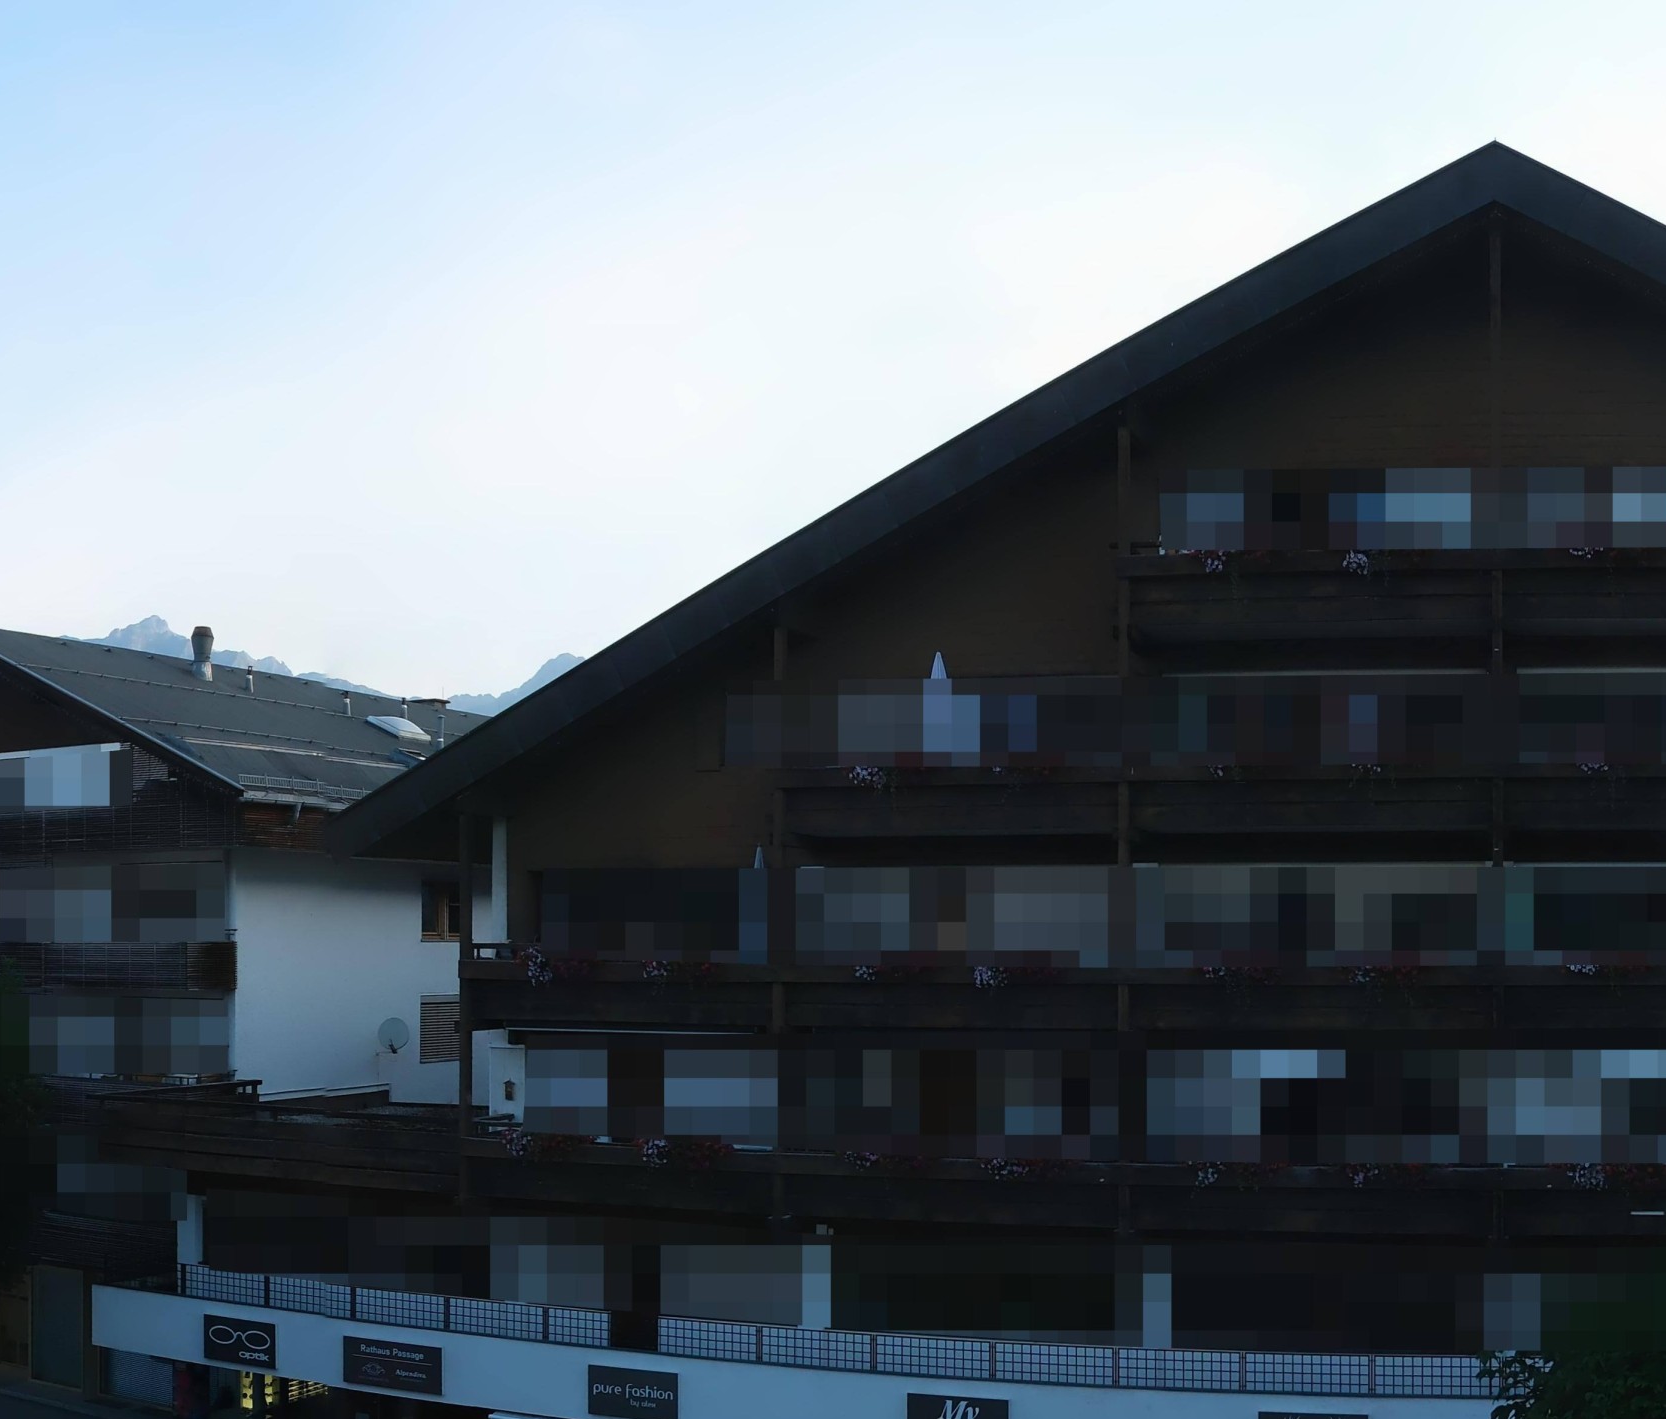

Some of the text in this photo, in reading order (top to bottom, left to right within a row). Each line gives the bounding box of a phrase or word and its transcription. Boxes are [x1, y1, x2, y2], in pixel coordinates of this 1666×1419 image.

[238, 1351, 270, 1362] optik
[360, 1343, 424, 1361] Rathaus Passage
[592, 1383, 674, 1401] pure fashion
